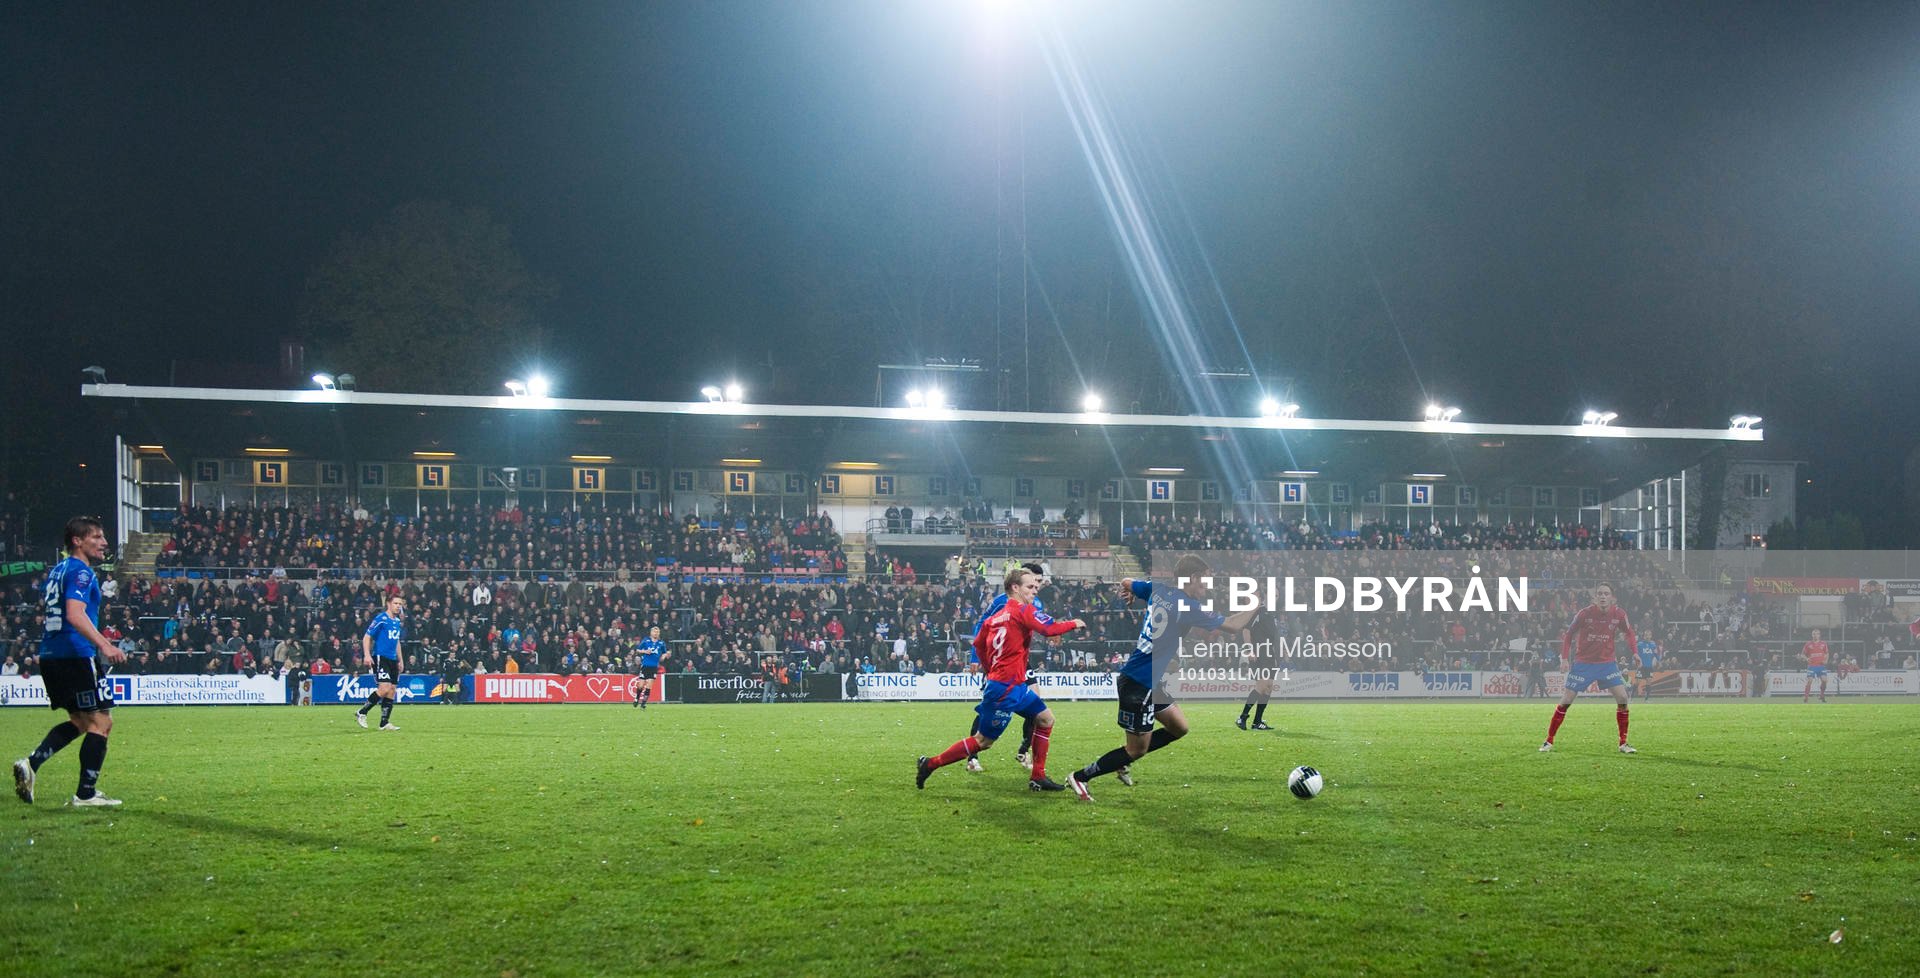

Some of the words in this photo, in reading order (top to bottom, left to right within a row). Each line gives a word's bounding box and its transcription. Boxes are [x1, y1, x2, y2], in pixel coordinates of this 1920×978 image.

[378, 672, 391, 680] ICA
[857, 675, 917, 687] GETINGE
[939, 675, 980, 687] GETIN
[1056, 675, 1080, 687] TALL
[1082, 675, 1113, 687] SHIPS
[137, 677, 241, 691] Länsförsäkringar
[485, 678, 547, 699] PUMA
[1179, 682, 1281, 693] ReklamSere
[1347, 681, 1397, 692] KPMG
[1420, 681, 1471, 692] KPMG
[1678, 672, 1742, 693] IMAB
[0, 684, 50, 701] äkrin
[137, 689, 266, 703] Fastighetsförmedling
